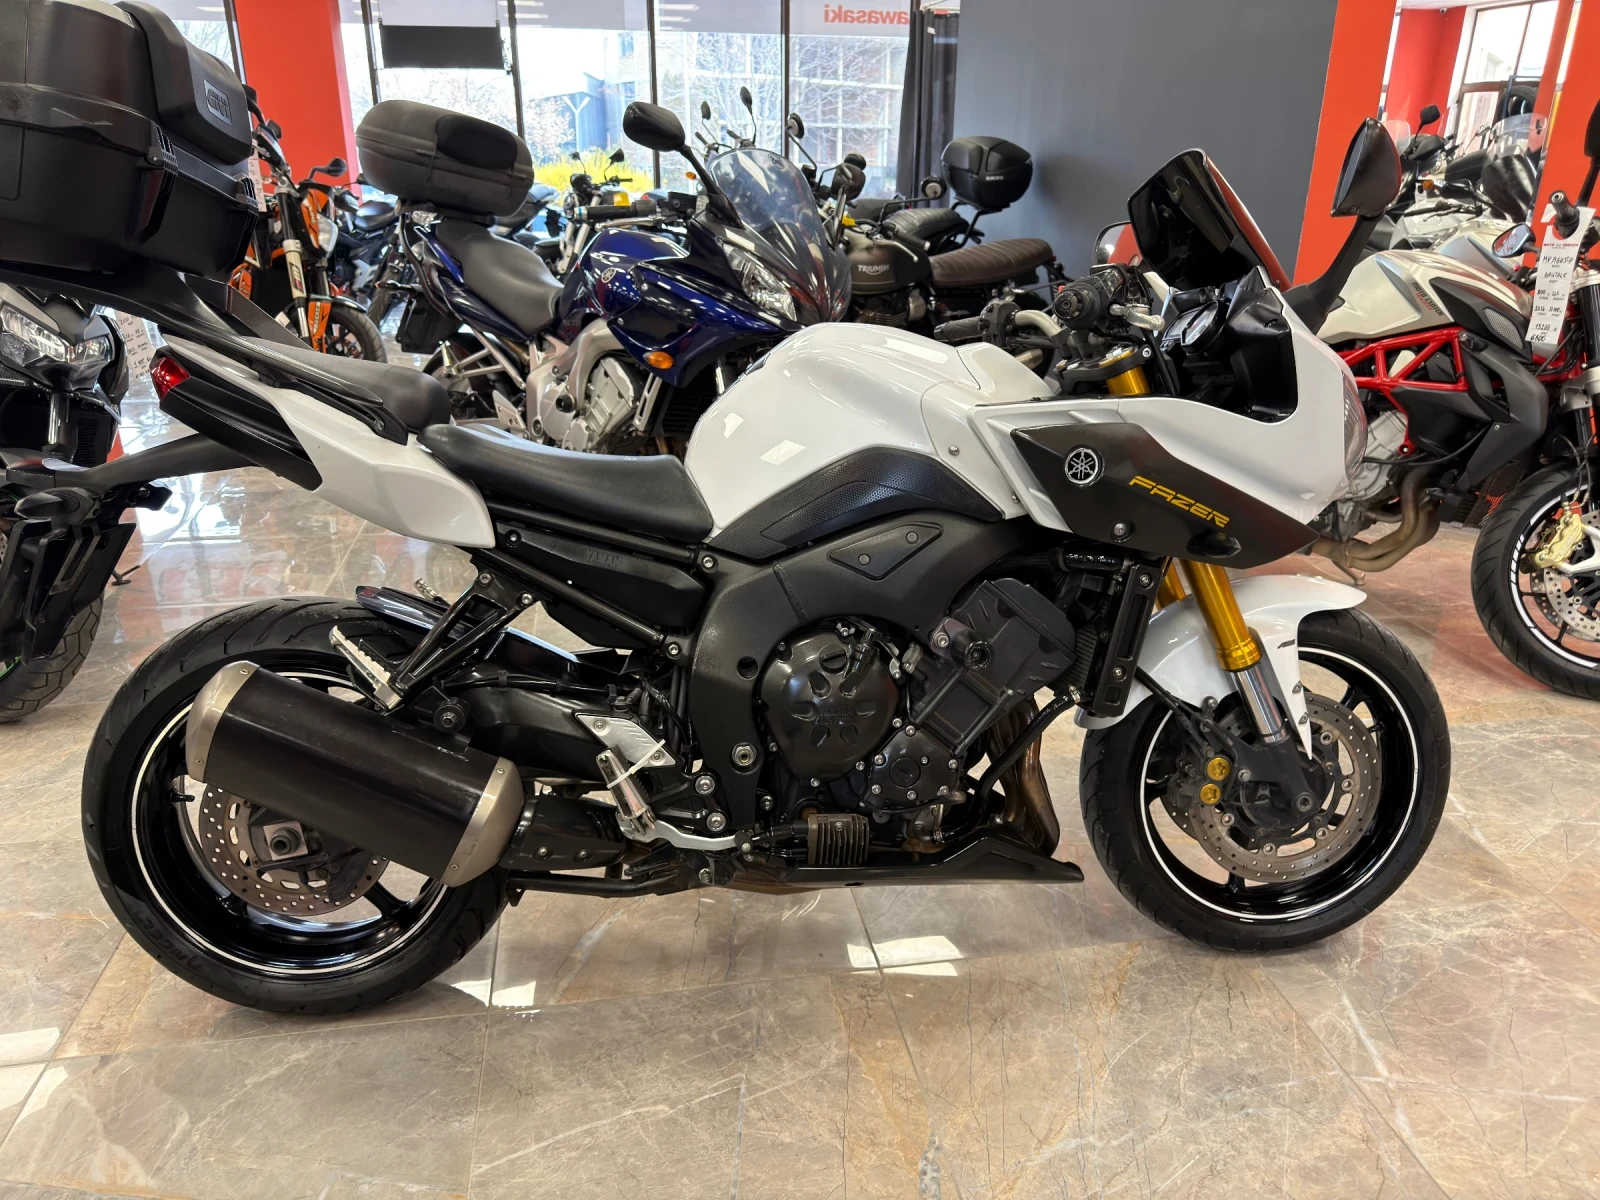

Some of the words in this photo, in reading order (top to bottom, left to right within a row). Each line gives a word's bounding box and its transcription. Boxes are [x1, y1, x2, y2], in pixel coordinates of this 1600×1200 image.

[858, 264, 890, 272] TRIUMPH
[1128, 475, 1230, 528] FAZER
[584, 549, 624, 568] YAMAH
